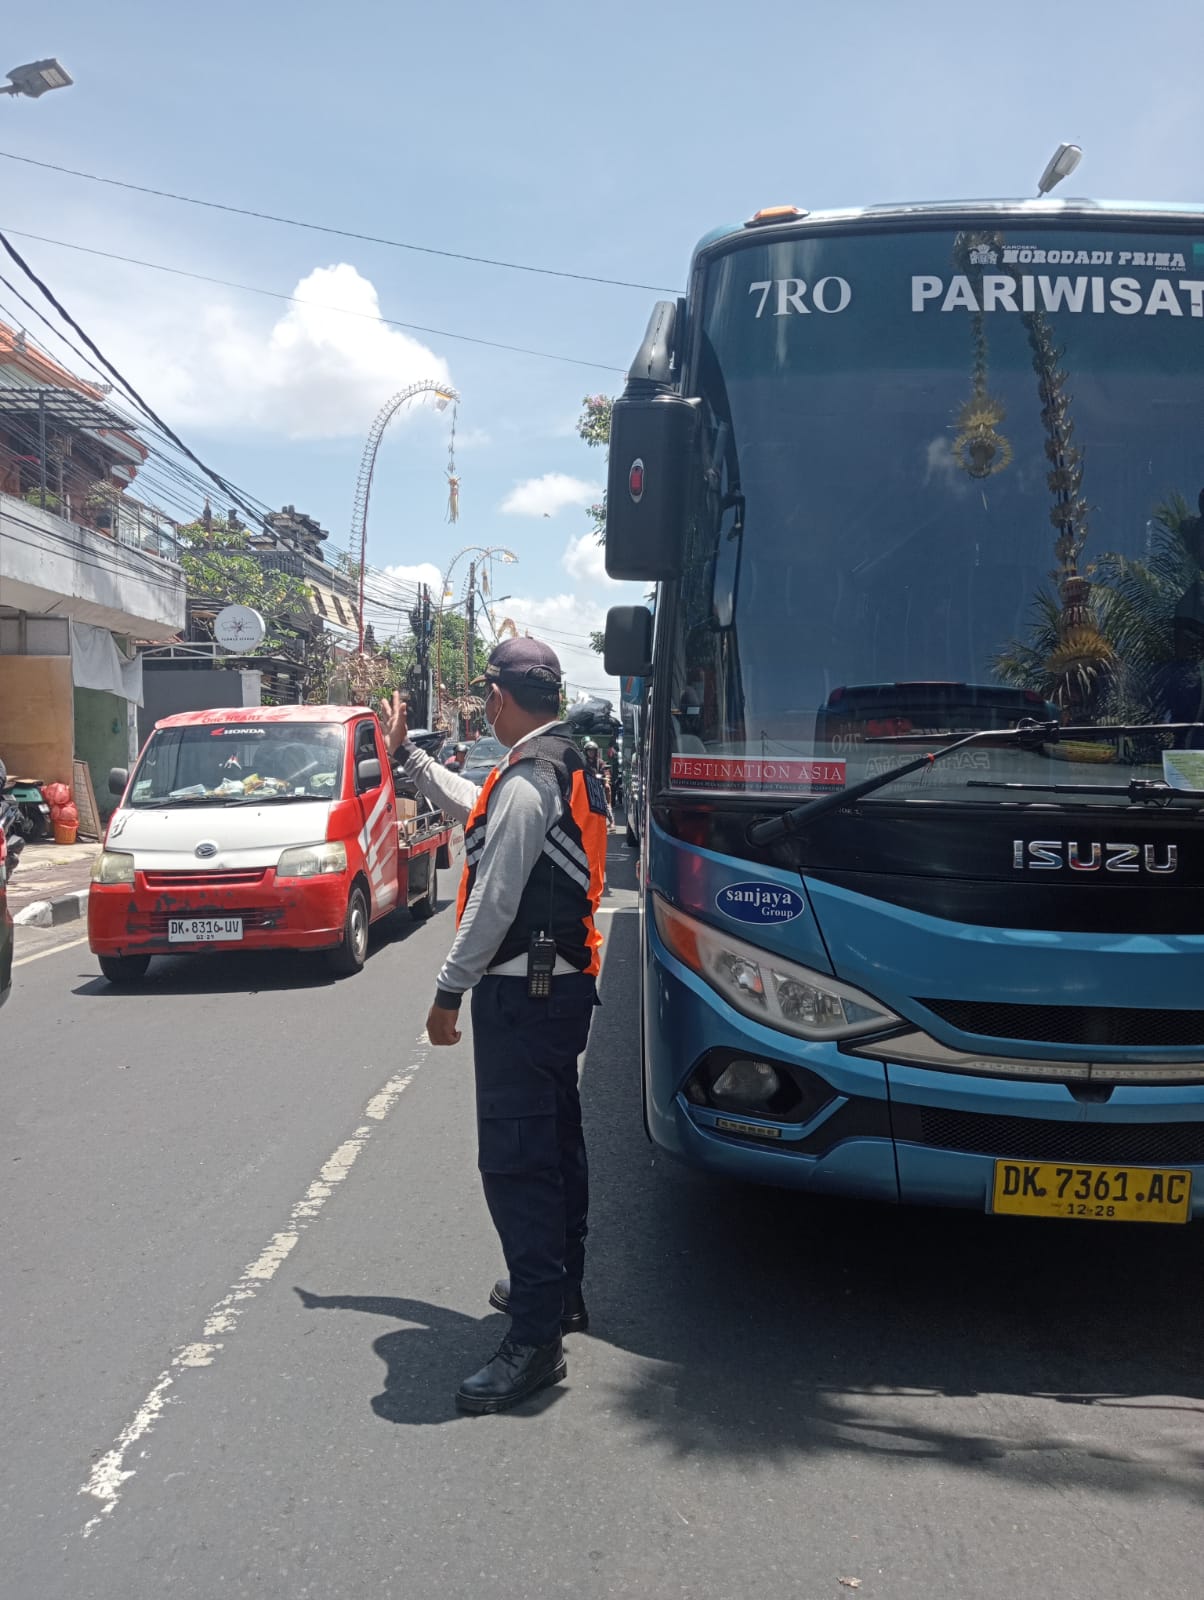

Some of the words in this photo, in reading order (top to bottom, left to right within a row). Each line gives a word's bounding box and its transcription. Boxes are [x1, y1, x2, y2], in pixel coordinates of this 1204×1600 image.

[1002, 250, 1114, 265] MORODADI
[1118, 252, 1186, 267] PRIMA
[748, 276, 851, 318] 7RO
[911, 275, 1204, 318] PARIWISAT
[673, 762, 790, 778] DESTINATION
[797, 766, 842, 780] ASIA
[1013, 840, 1177, 873] ISUZU
[726, 888, 792, 907] sanjaya
[761, 907, 793, 919] Group
[171, 921, 185, 934] DK
[191, 921, 220, 933] 8316
[225, 920, 239, 932] UV
[1003, 1165, 1041, 1197] DK
[1055, 1168, 1128, 1202] 7361
[1147, 1174, 1186, 1204] AC
